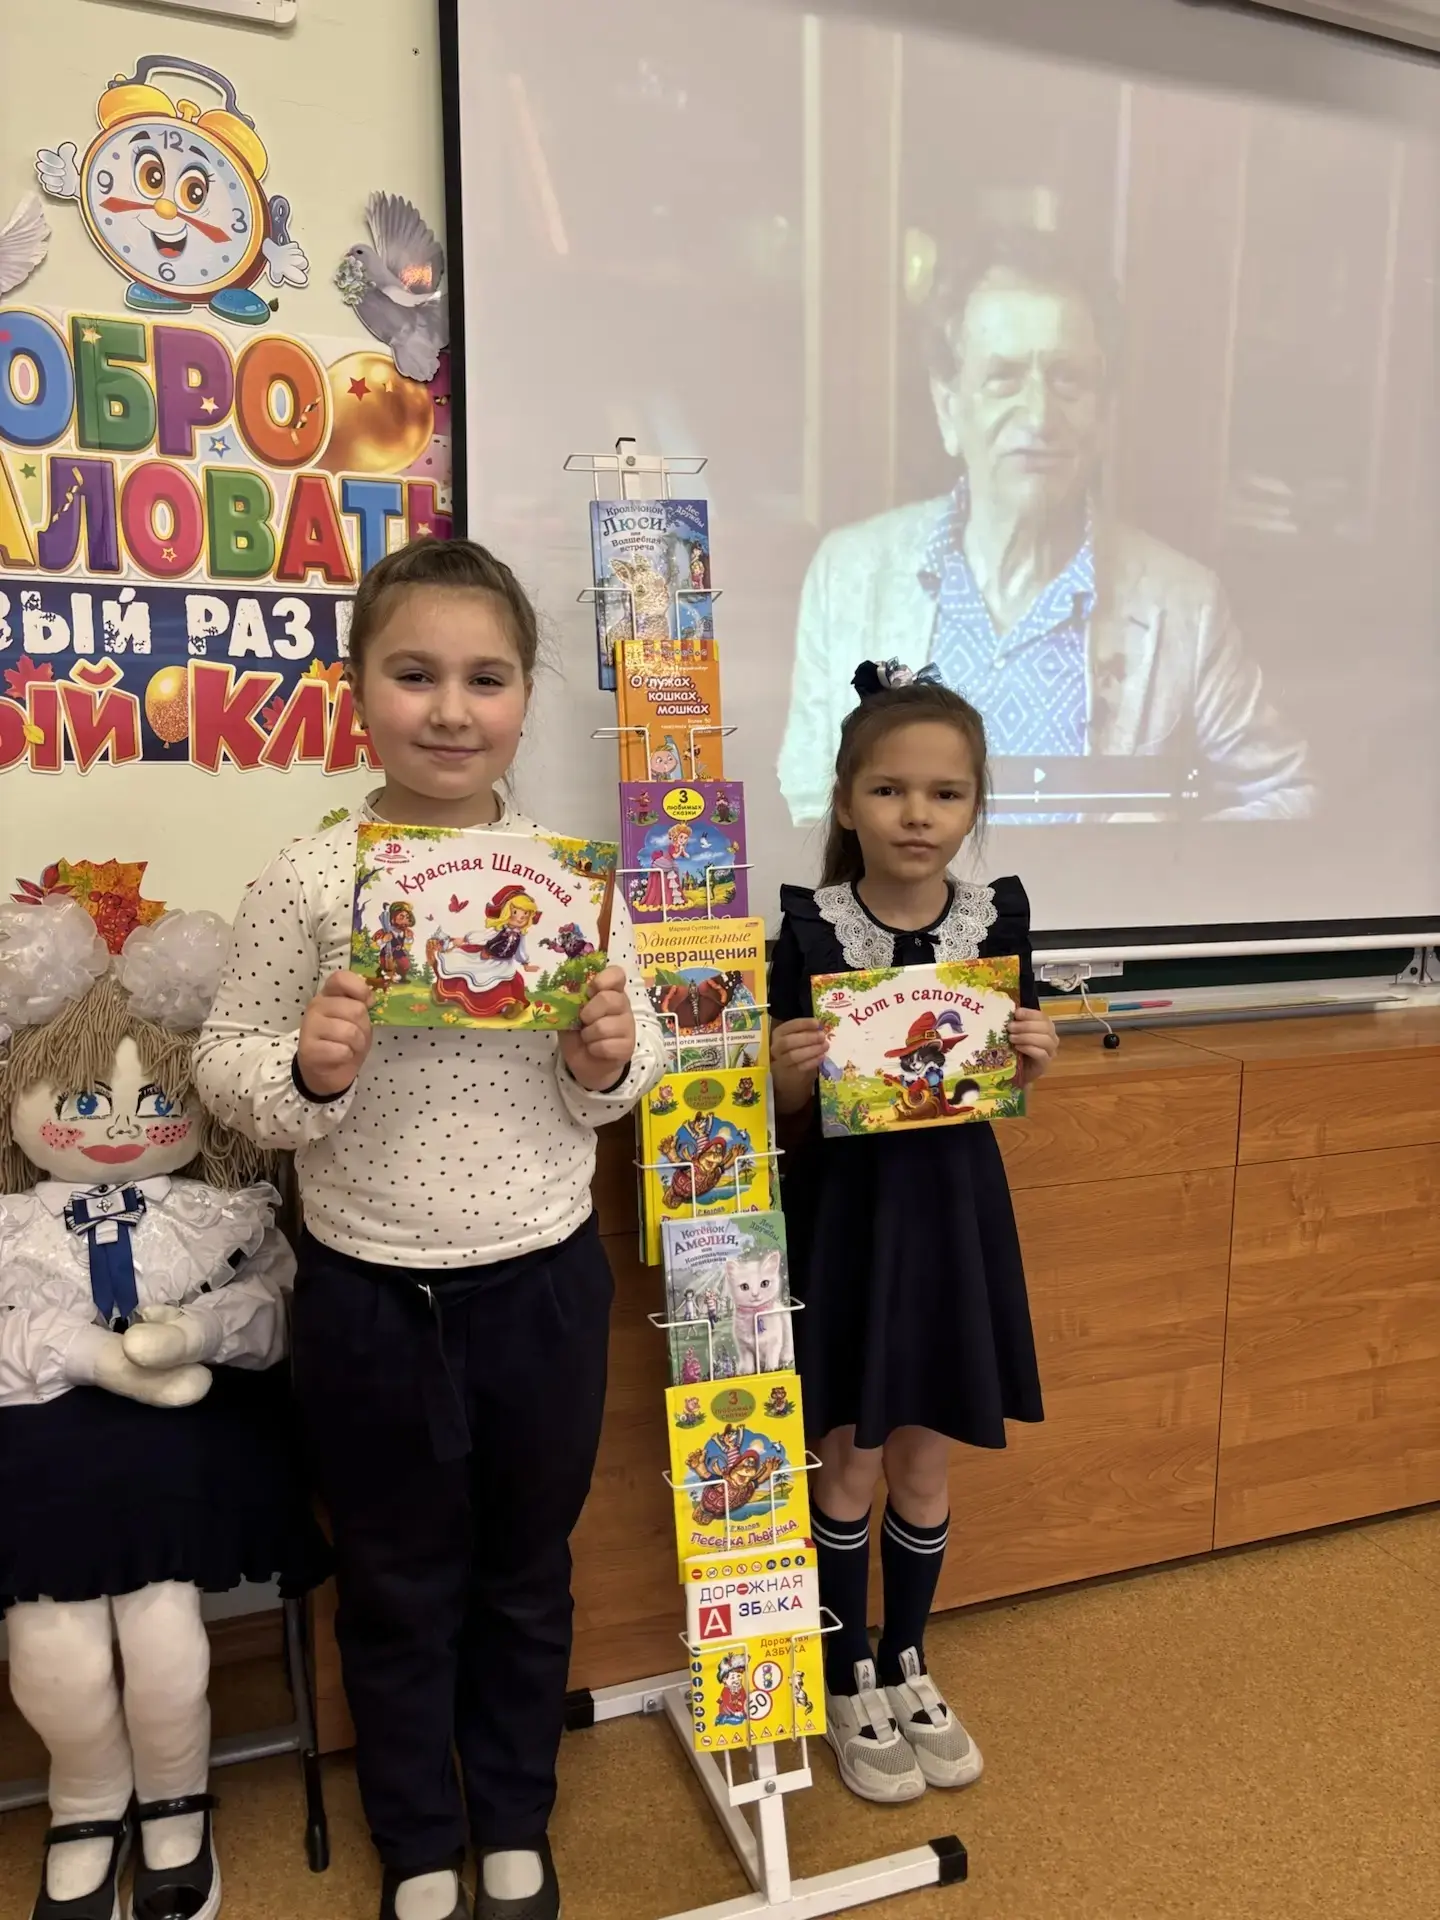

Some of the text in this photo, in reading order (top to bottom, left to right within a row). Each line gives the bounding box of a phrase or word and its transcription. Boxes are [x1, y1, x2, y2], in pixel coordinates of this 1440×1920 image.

[158, 131, 184, 153] 12
[96, 170, 115, 195] 9
[230, 208, 248, 233] 3
[157, 262, 176, 282] 6
[675, 505, 706, 529] Дружбы
[685, 504, 700, 516] Лес
[601, 516, 668, 537] Люси,
[611, 535, 662, 547] Волшебная
[620, 544, 655, 553] встреча
[185, 594, 315, 660] РАЗ
[631, 675, 696, 690] О лужах,
[648, 691, 702, 703] кошках,
[657, 704, 709, 715] мошках
[679, 790, 688, 803] 3
[385, 843, 402, 854] 3D
[395, 853, 572, 907] Красная Шапочка
[637, 932, 751, 952] Удивительные
[831, 992, 845, 1002] 3D
[848, 989, 985, 1026] Кот в сапогах
[680, 1225, 725, 1240] Котёнок
[675, 1235, 739, 1256] Амелия,
[729, 1391, 738, 1405] 3
[748, 1693, 767, 1716] 50
